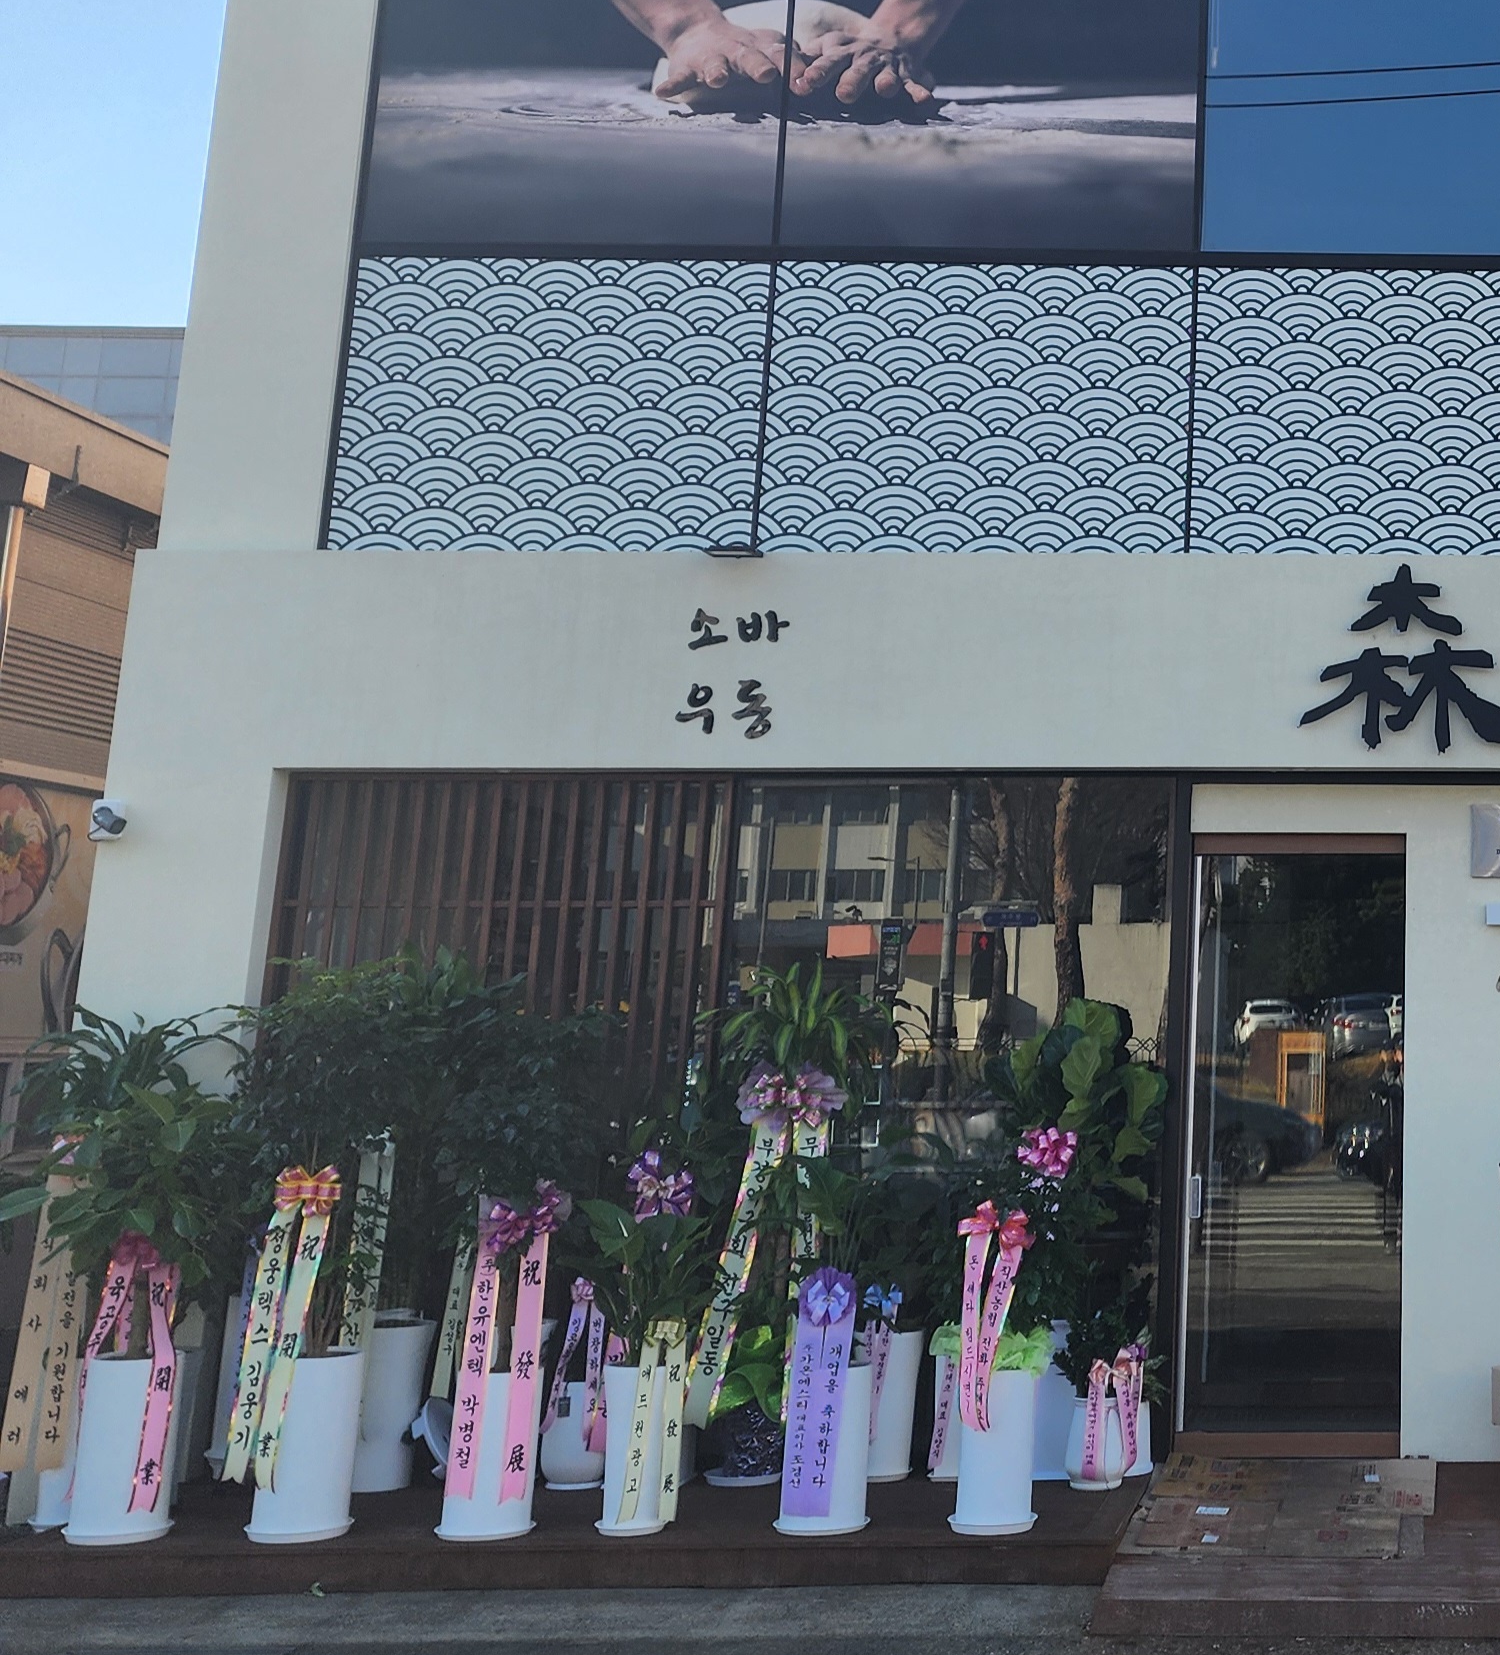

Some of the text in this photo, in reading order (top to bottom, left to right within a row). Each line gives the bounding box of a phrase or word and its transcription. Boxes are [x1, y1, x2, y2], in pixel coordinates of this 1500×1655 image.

[688, 608, 790, 650] 소바
[675, 679, 773, 739] 우동
[43, 1341, 70, 1445] 기원합니다
[454, 1393, 480, 1470] 박병철
[811, 1343, 844, 1490] 개업을 축하합니다
